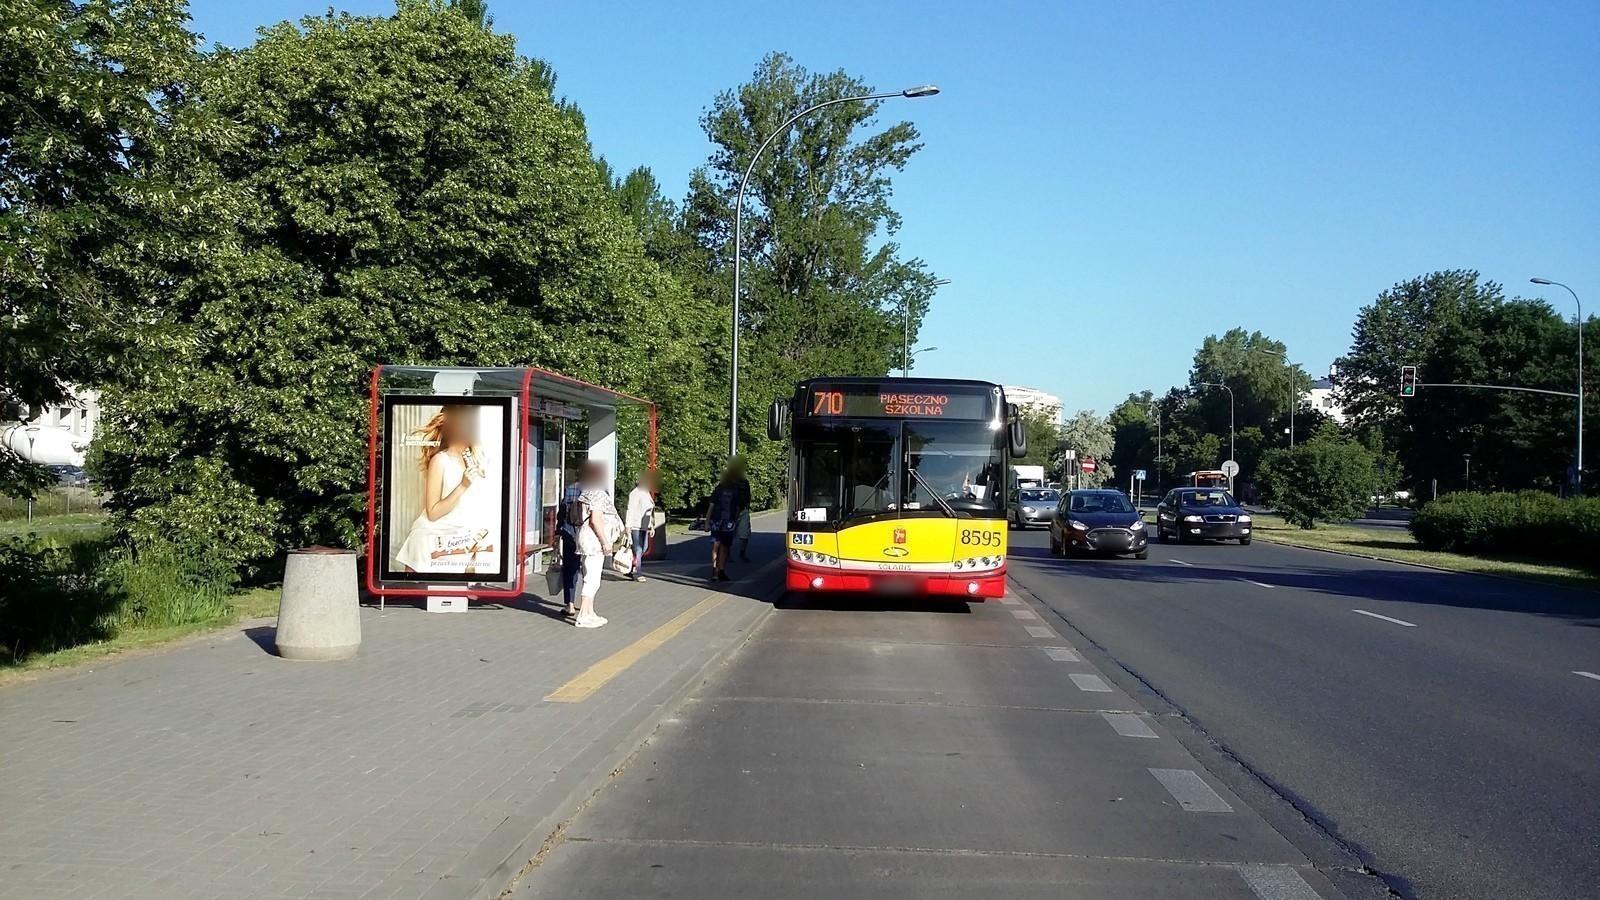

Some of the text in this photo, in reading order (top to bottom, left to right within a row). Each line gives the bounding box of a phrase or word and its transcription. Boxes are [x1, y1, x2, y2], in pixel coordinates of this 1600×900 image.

[814, 391, 843, 415] 710
[880, 394, 948, 405] PIASECZNO
[885, 405, 943, 415] SZKOLNA
[961, 529, 1002, 548] 8595
